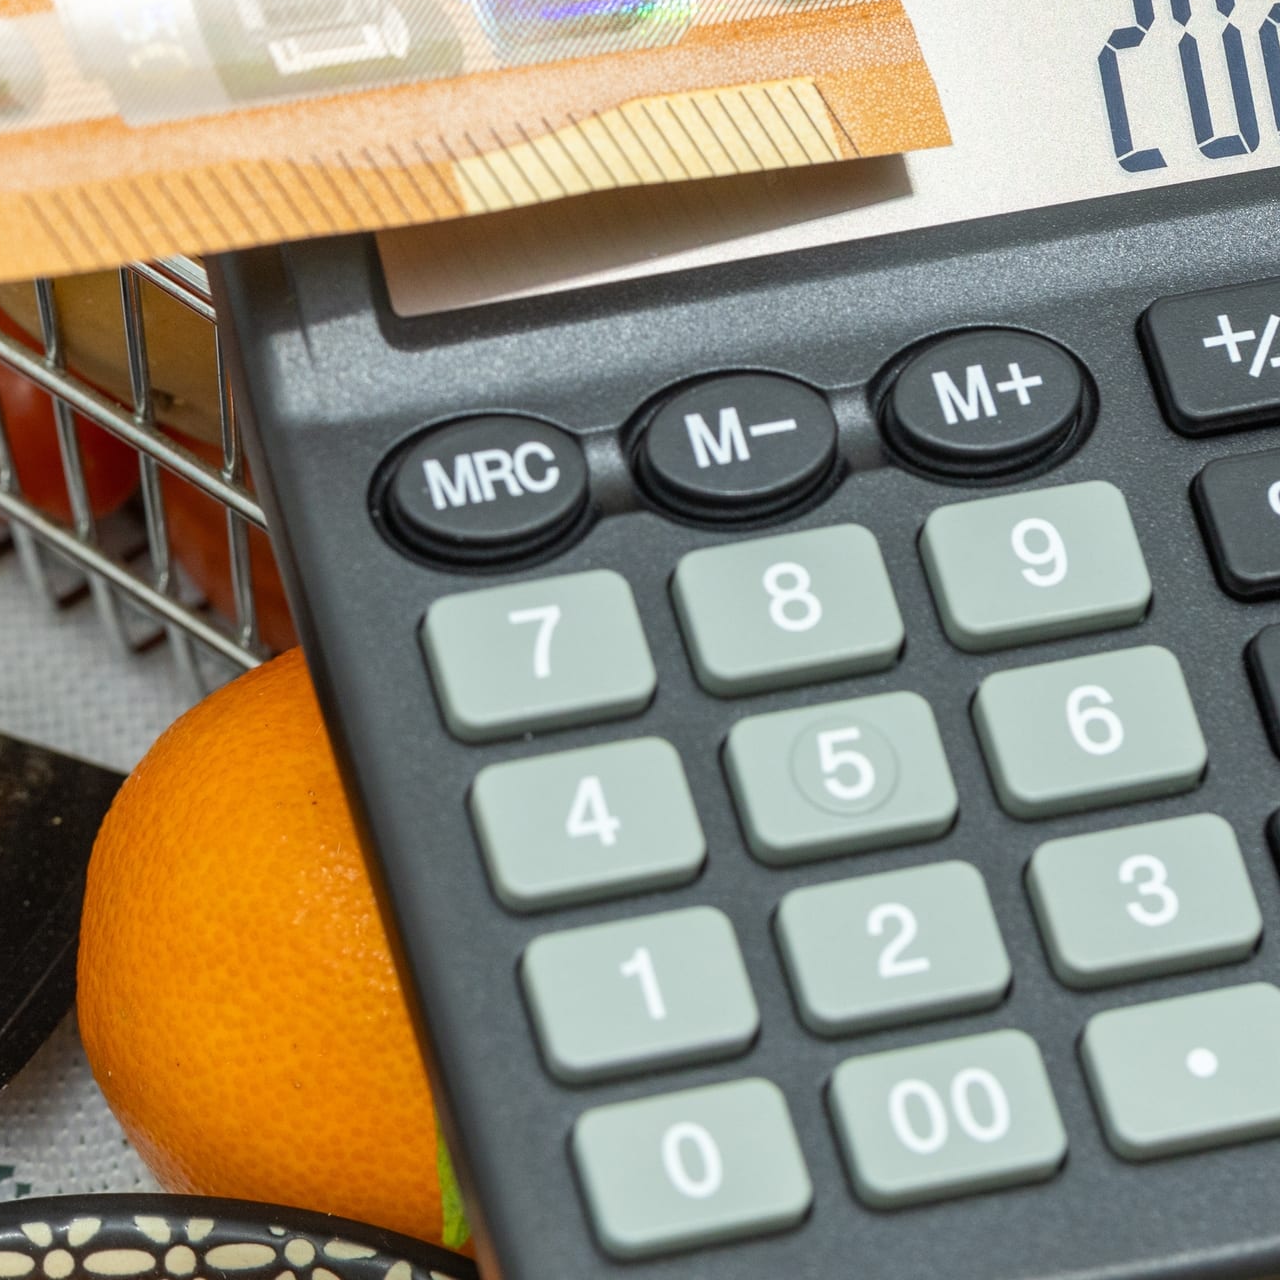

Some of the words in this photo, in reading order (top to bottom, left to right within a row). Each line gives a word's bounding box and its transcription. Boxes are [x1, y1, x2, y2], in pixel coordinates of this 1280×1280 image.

[931, 362, 1043, 425] M+
[684, 406, 797, 468] M-
[423, 441, 560, 510] MRC
[1011, 517, 1068, 587] 9
[763, 562, 822, 632] 8
[508, 605, 561, 679] 7
[1066, 685, 1124, 755] 6
[817, 726, 875, 800] 5
[566, 776, 620, 846] 4
[1118, 854, 1179, 927] 3
[867, 903, 930, 978] 2
[620, 948, 666, 1020] 1
[889, 1068, 1010, 1154] 00
[662, 1122, 722, 1198] 0
